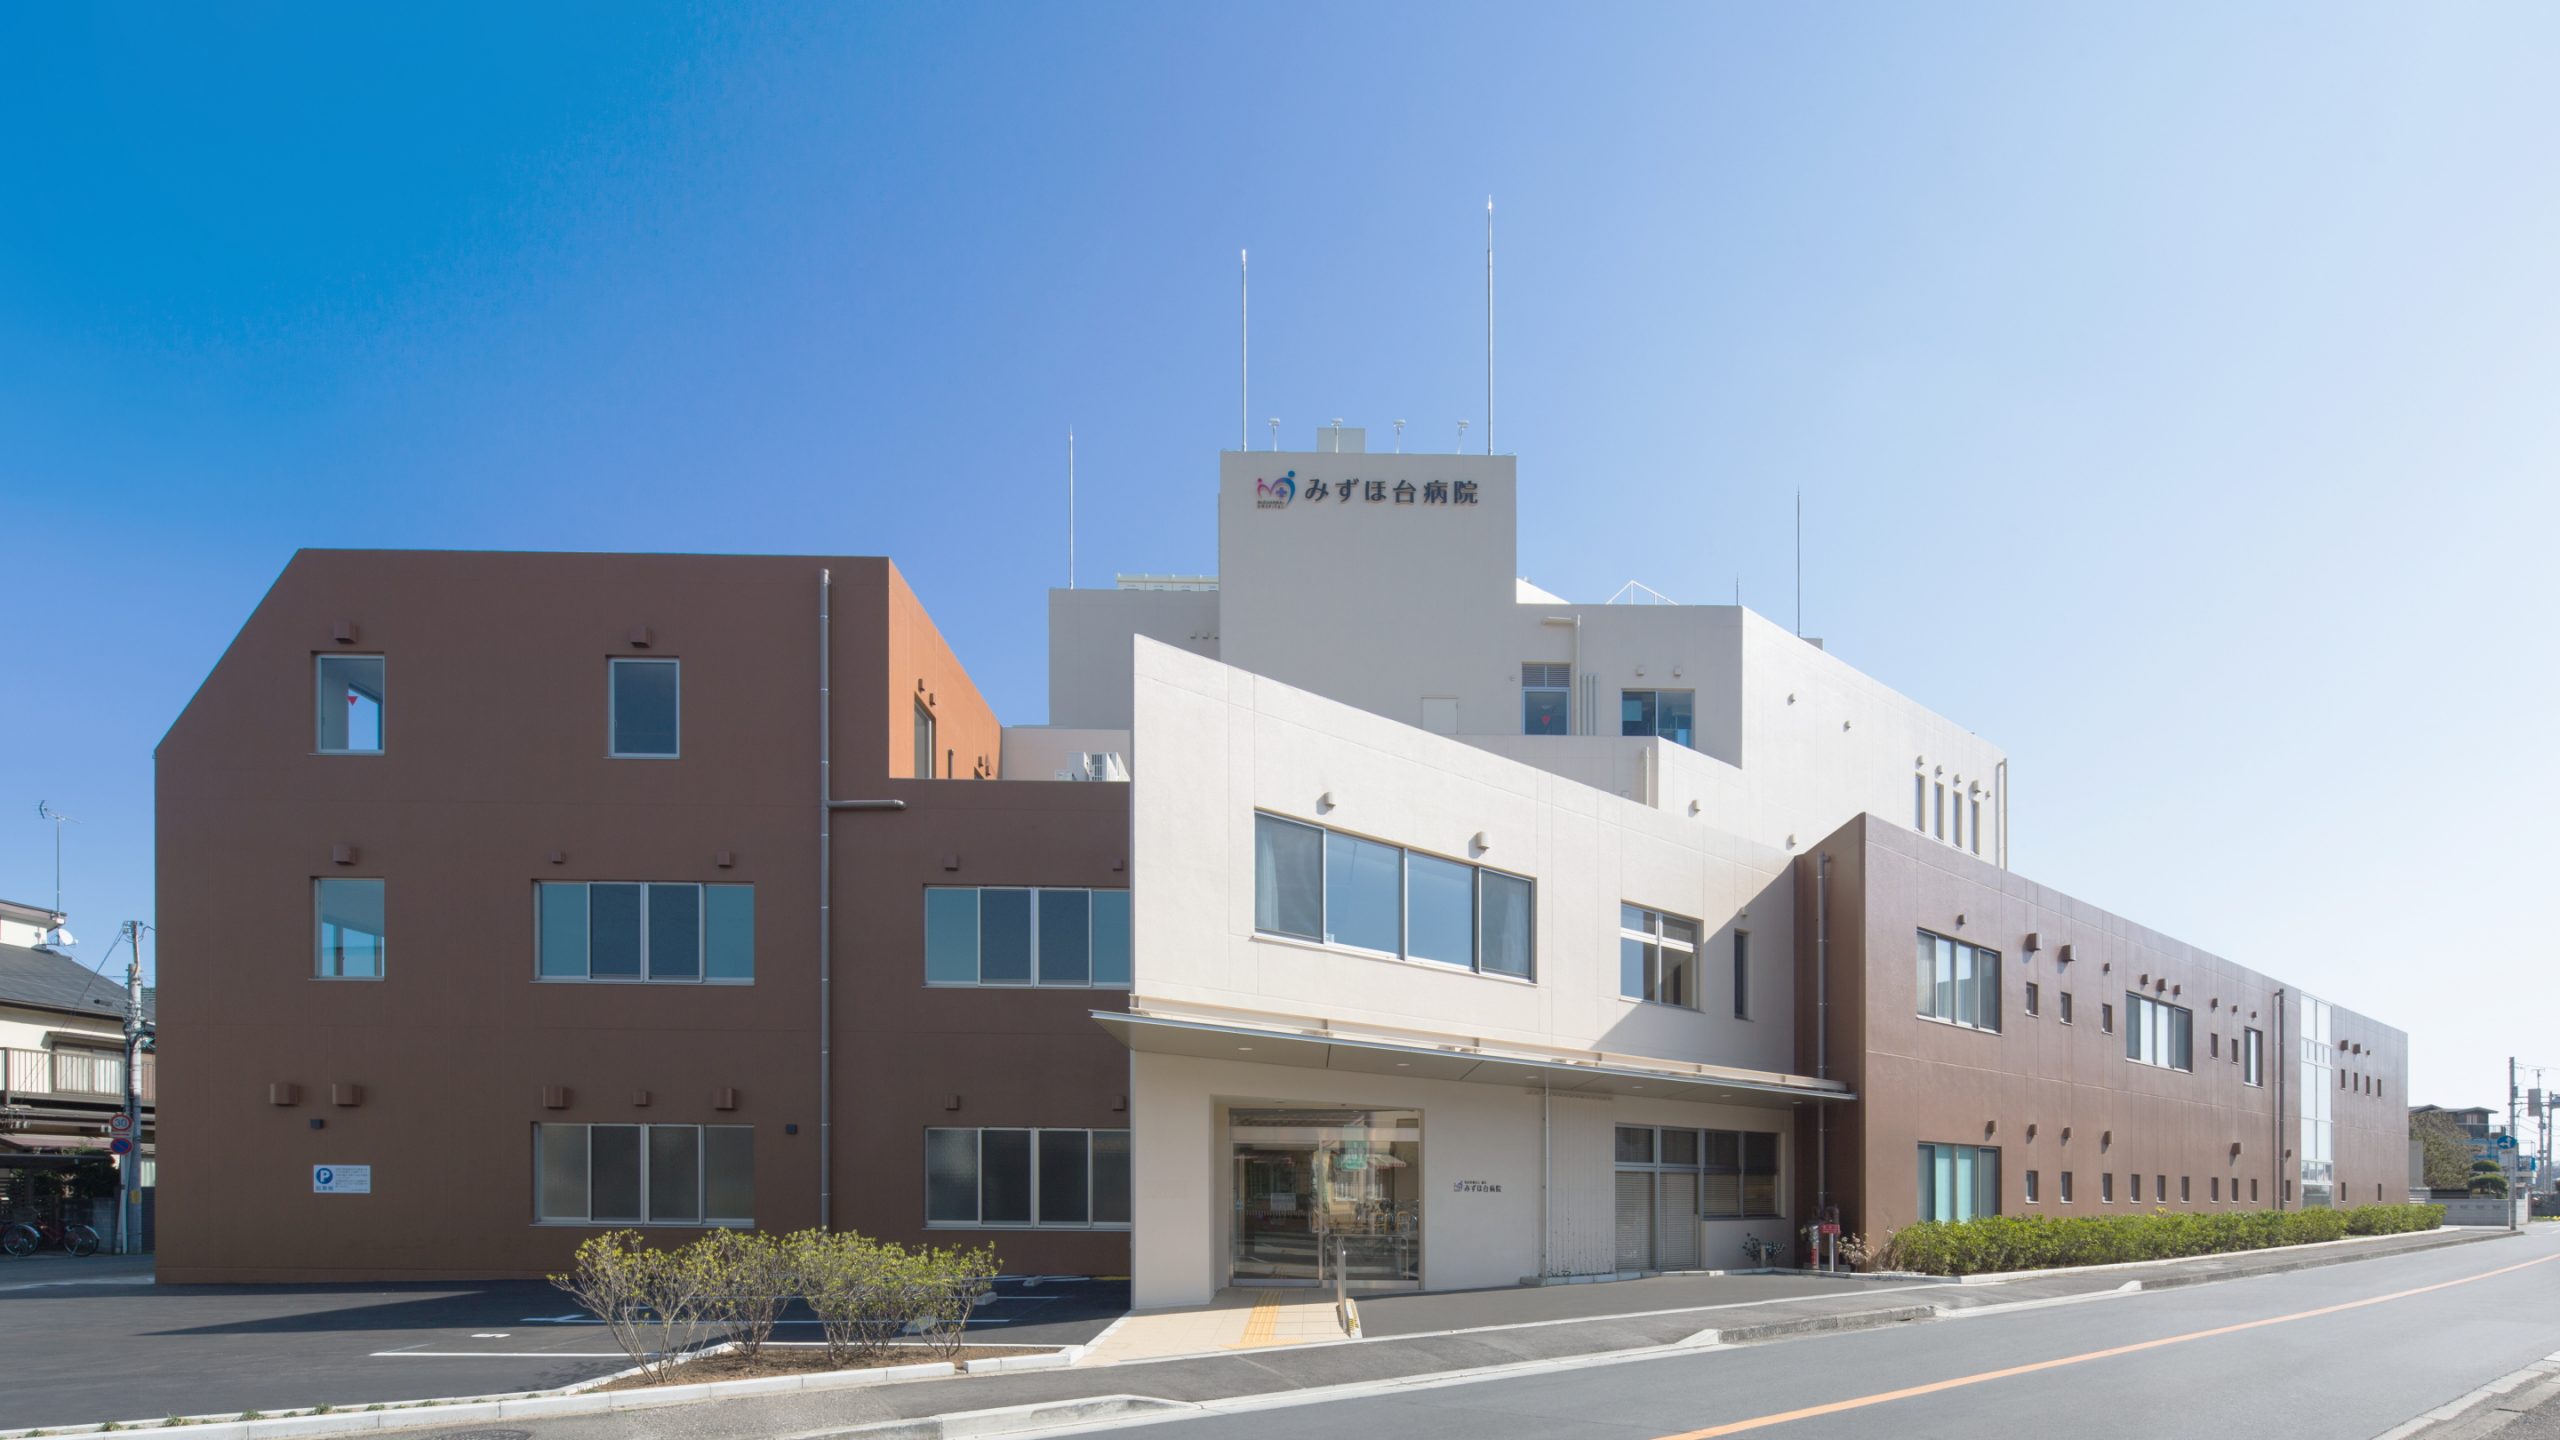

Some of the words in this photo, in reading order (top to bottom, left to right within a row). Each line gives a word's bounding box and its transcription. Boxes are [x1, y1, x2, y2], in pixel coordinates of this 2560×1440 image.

[1305, 478, 1479, 504] みずほ台病院
[115, 1118, 128, 1127] 30
[320, 1170, 330, 1182] P
